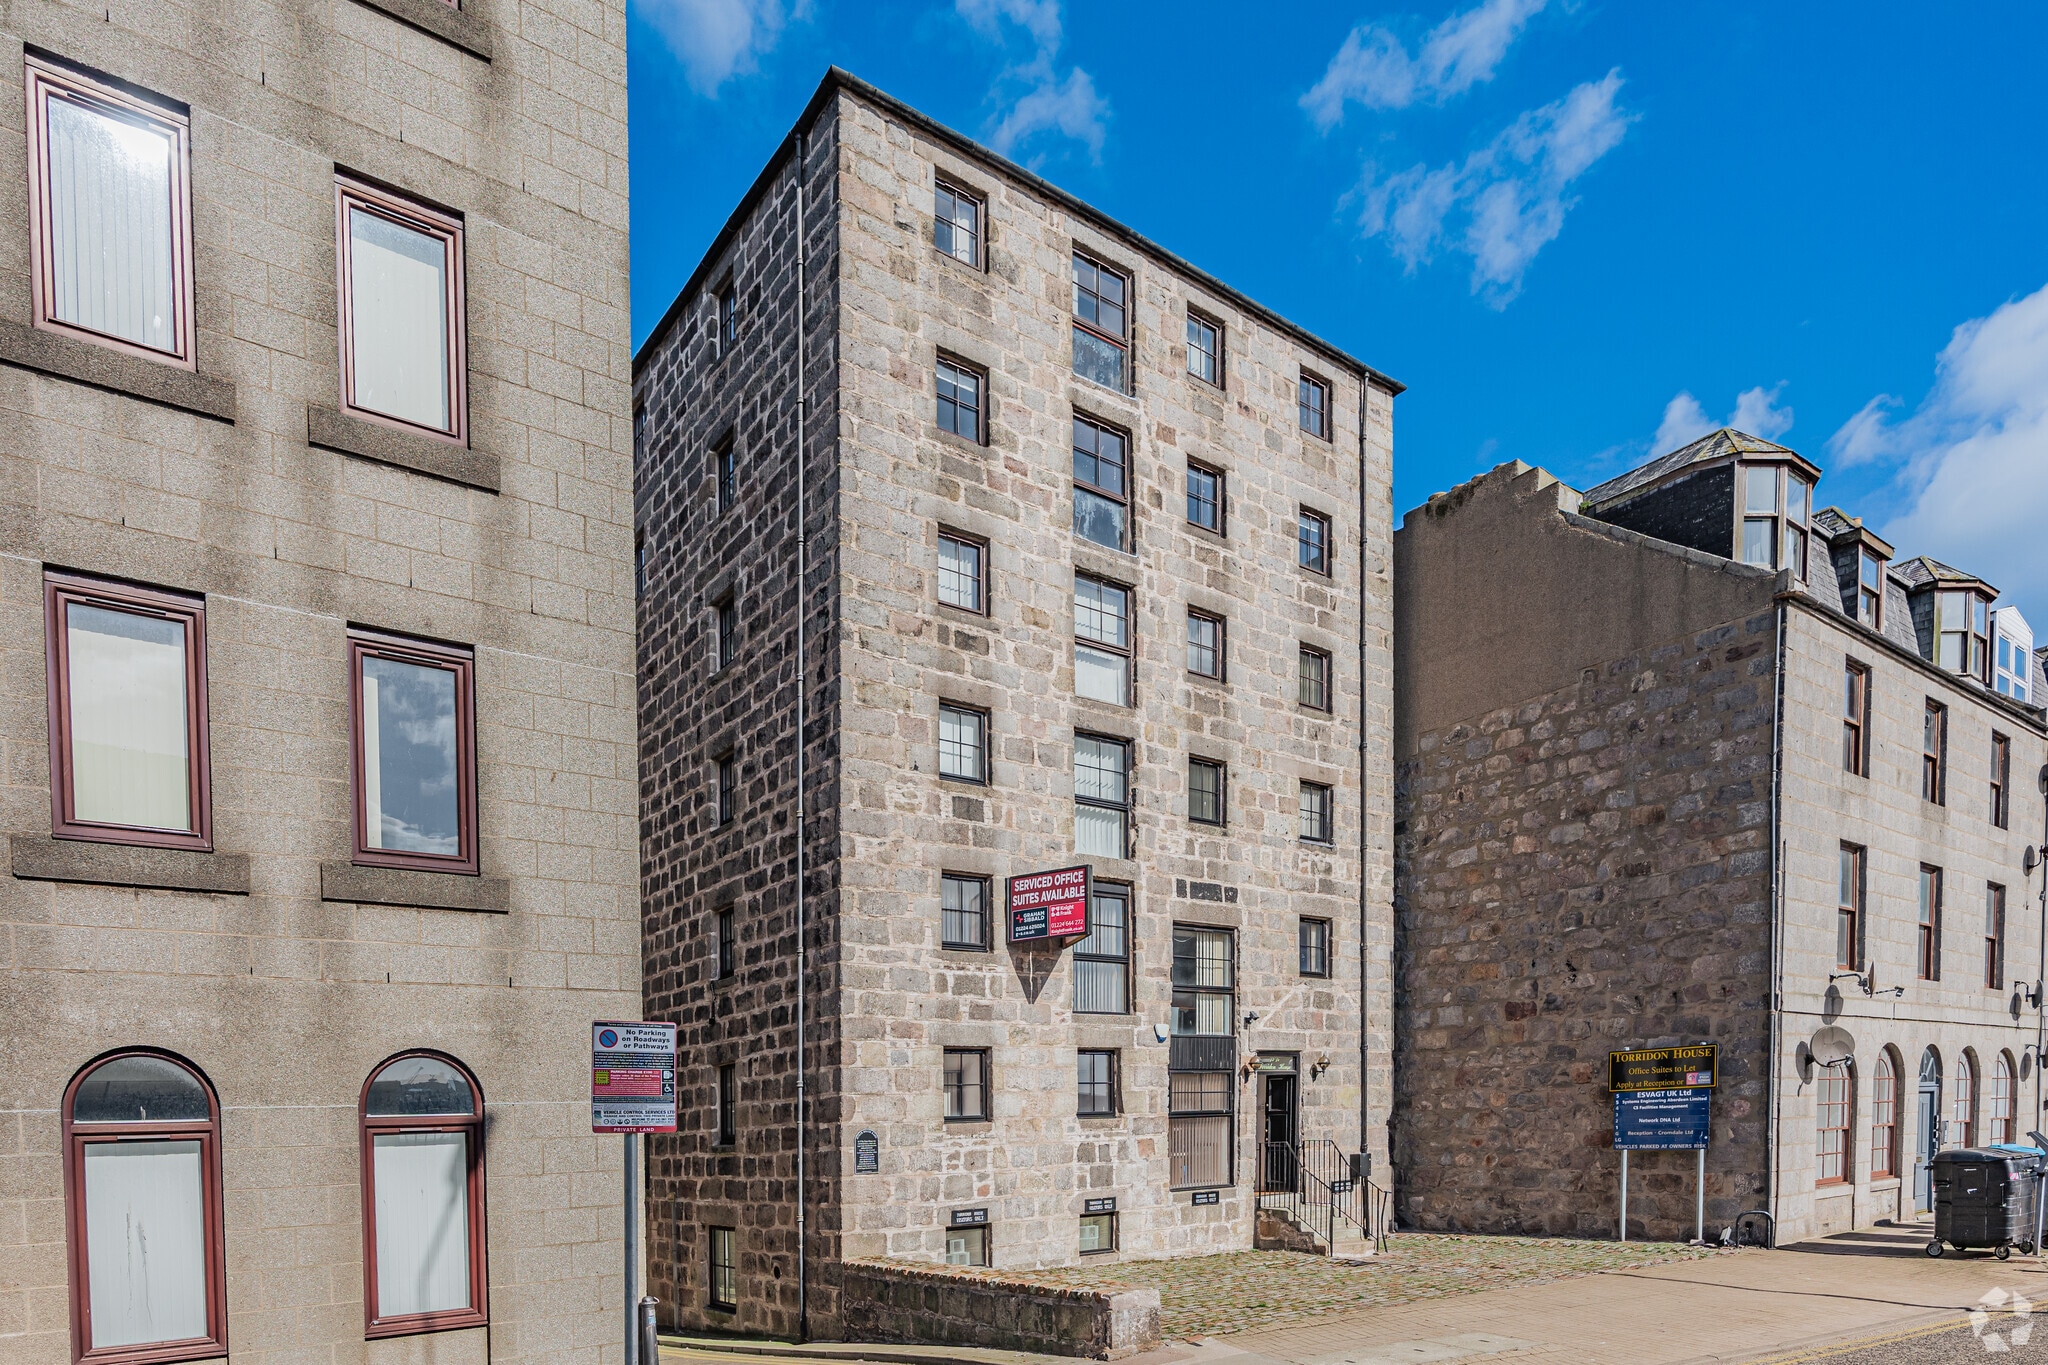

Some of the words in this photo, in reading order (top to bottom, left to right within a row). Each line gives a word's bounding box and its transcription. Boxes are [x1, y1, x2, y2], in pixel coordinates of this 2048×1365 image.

[1014, 876, 1052, 892] SERVICED
[1054, 871, 1084, 886] OFFICE
[1012, 892, 1039, 906] SUITES
[1041, 885, 1085, 902] AVAILABLE
[1614, 1051, 1669, 1063] TORRIDON
[1673, 1048, 1712, 1059] HOUSE
[1628, 1067, 1650, 1075] Office
[1651, 1066, 1673, 1074] Suites
[1616, 1081, 1634, 1089] Apply
[1644, 1079, 1675, 1088] Reception
